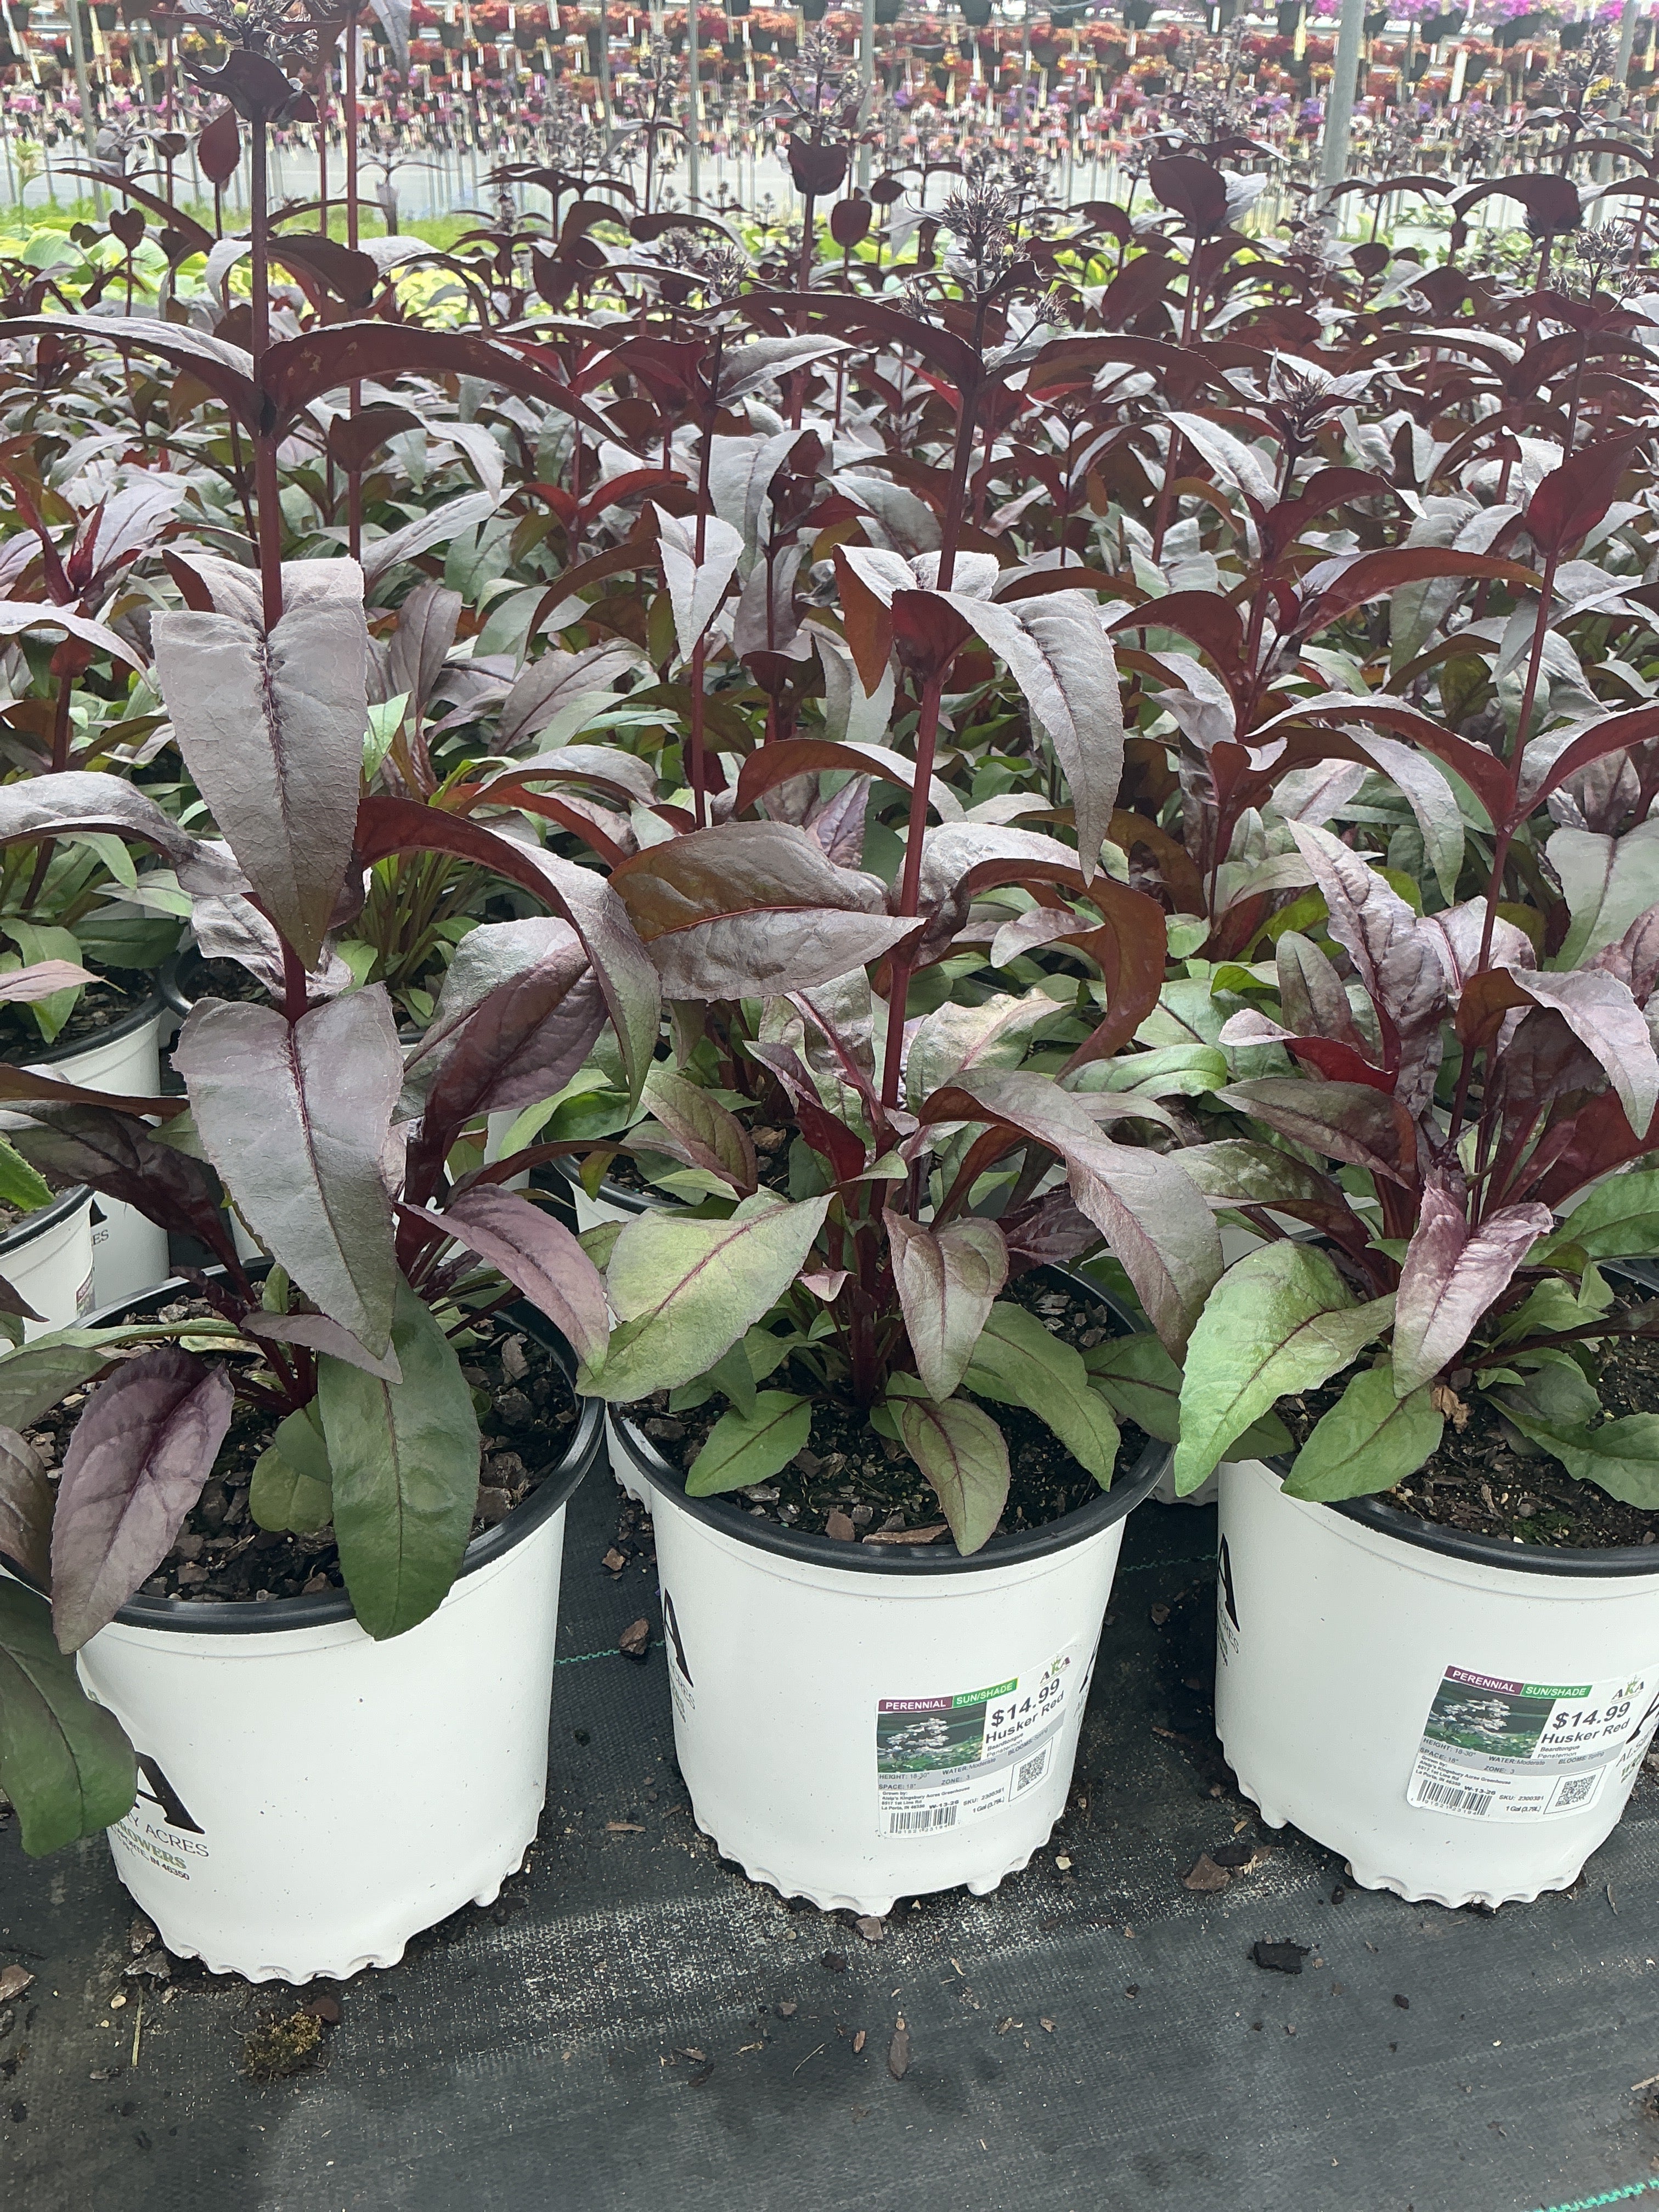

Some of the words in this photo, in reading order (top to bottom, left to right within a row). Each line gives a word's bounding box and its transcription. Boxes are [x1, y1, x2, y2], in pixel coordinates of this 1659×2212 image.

[1040, 1656, 1071, 1684] AKA
[1452, 1670, 1515, 1692] PERENNIAL
[1525, 1686, 1587, 1696] SUN/SHADE
[885, 1700, 946, 1710] PERENNIAL
[956, 1682, 1013, 1705] SUN/SHADE
[991, 1678, 1060, 1728] $14.99
[1611, 1679, 1644, 1700] AKA
[986, 1712, 1039, 1743] Husker
[1041, 1690, 1064, 1717] Red
[1552, 1701, 1630, 1730] $14.99
[1423, 1737, 1453, 1752] HEIGHT:
[1541, 1730, 1600, 1744] Husker
[1602, 1717, 1631, 1736] Red
[1419, 1747, 1447, 1760] SPACE:
[941, 1777, 962, 1786] ZONE:
[117, 1821, 187, 1869] ROWERS
[145, 1824, 210, 1857] ACRES
